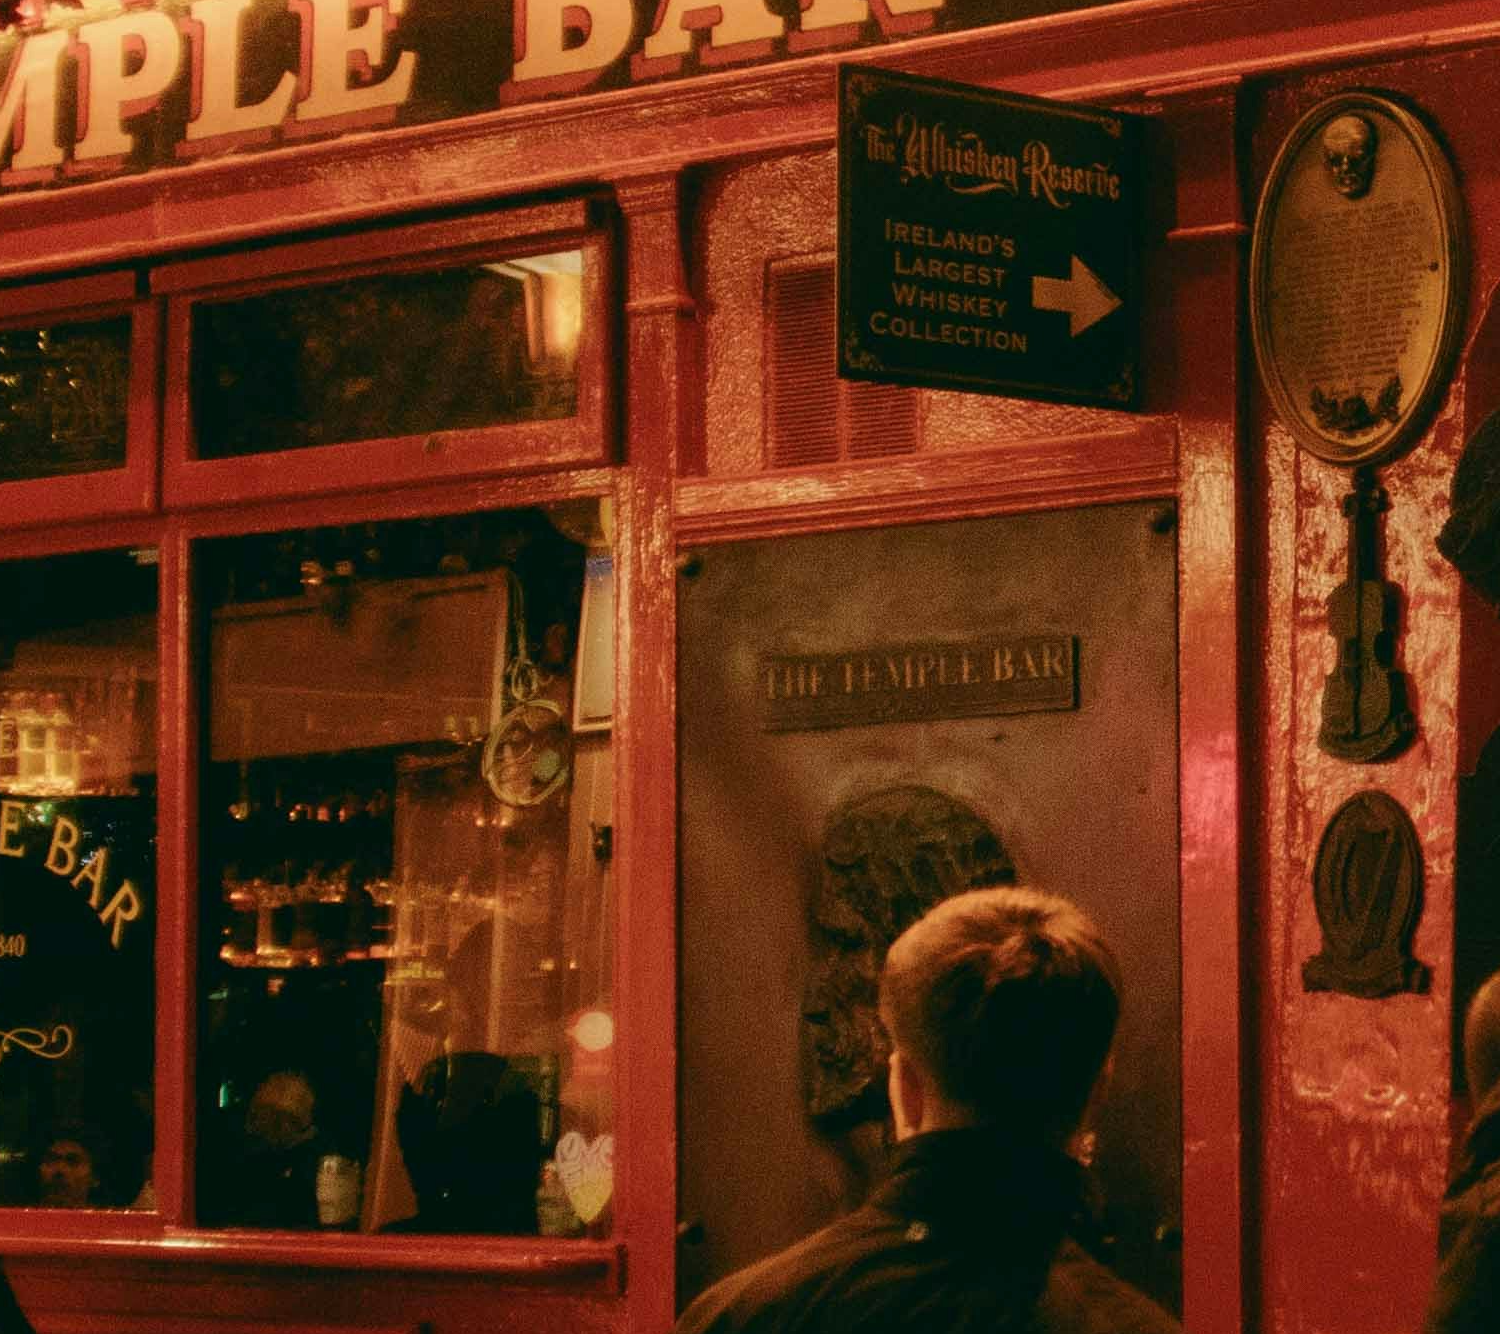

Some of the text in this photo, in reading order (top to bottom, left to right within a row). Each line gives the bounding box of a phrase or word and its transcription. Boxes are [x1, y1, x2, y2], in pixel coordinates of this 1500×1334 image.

[864, 114, 1122, 208] The Whiskey Reserve
[884, 217, 1017, 260] IRELAND'S
[894, 250, 1006, 289] LARGEST
[891, 281, 1010, 320] WHISKEY
[868, 308, 1028, 354] COLLECTION
[762, 646, 1068, 700] THE TEMPLE BAR
[44, 816, 146, 948] BAR
